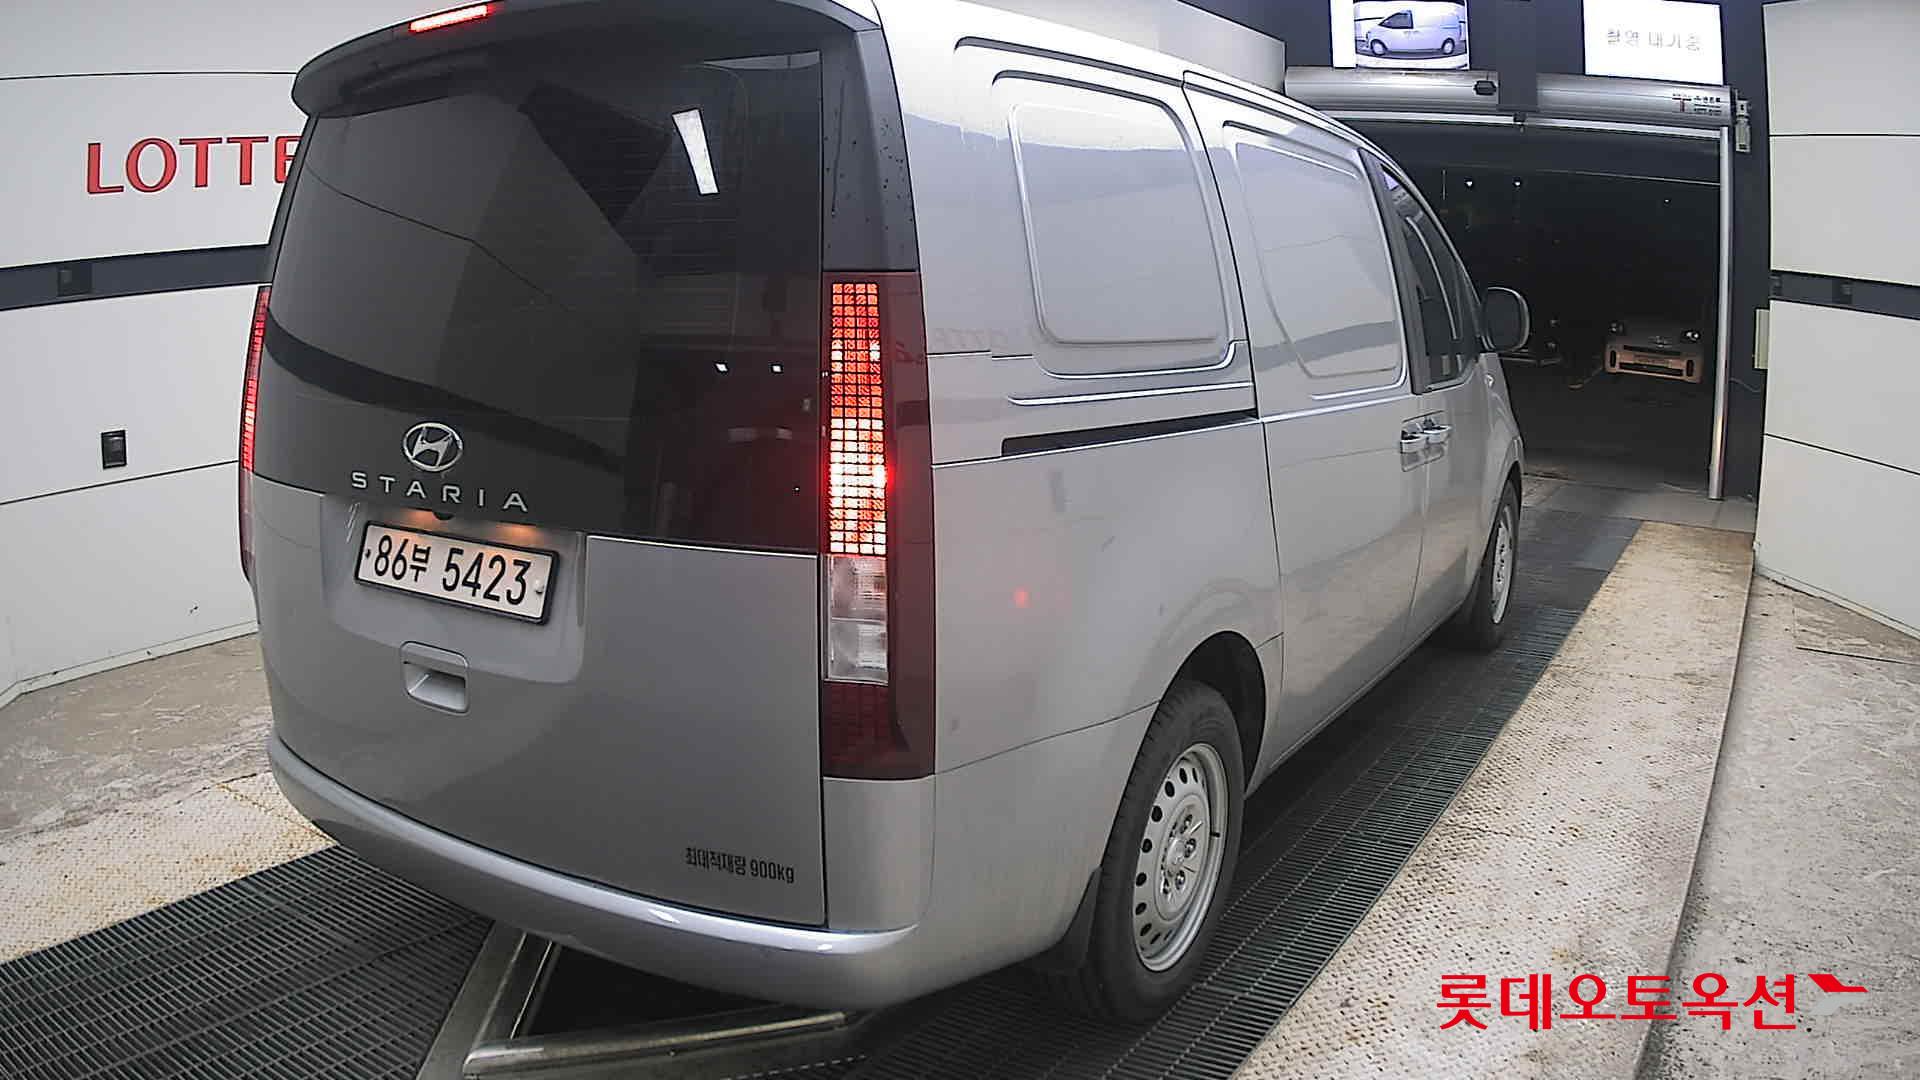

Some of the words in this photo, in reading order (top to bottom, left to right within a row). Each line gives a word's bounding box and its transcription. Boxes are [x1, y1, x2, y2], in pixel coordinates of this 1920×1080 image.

[351, 471, 528, 512] STARIA
[373, 534, 431, 583] 86부
[442, 547, 532, 606] 5423
[685, 847, 746, 876] 최대적재량
[750, 858, 795, 884] 900kg
